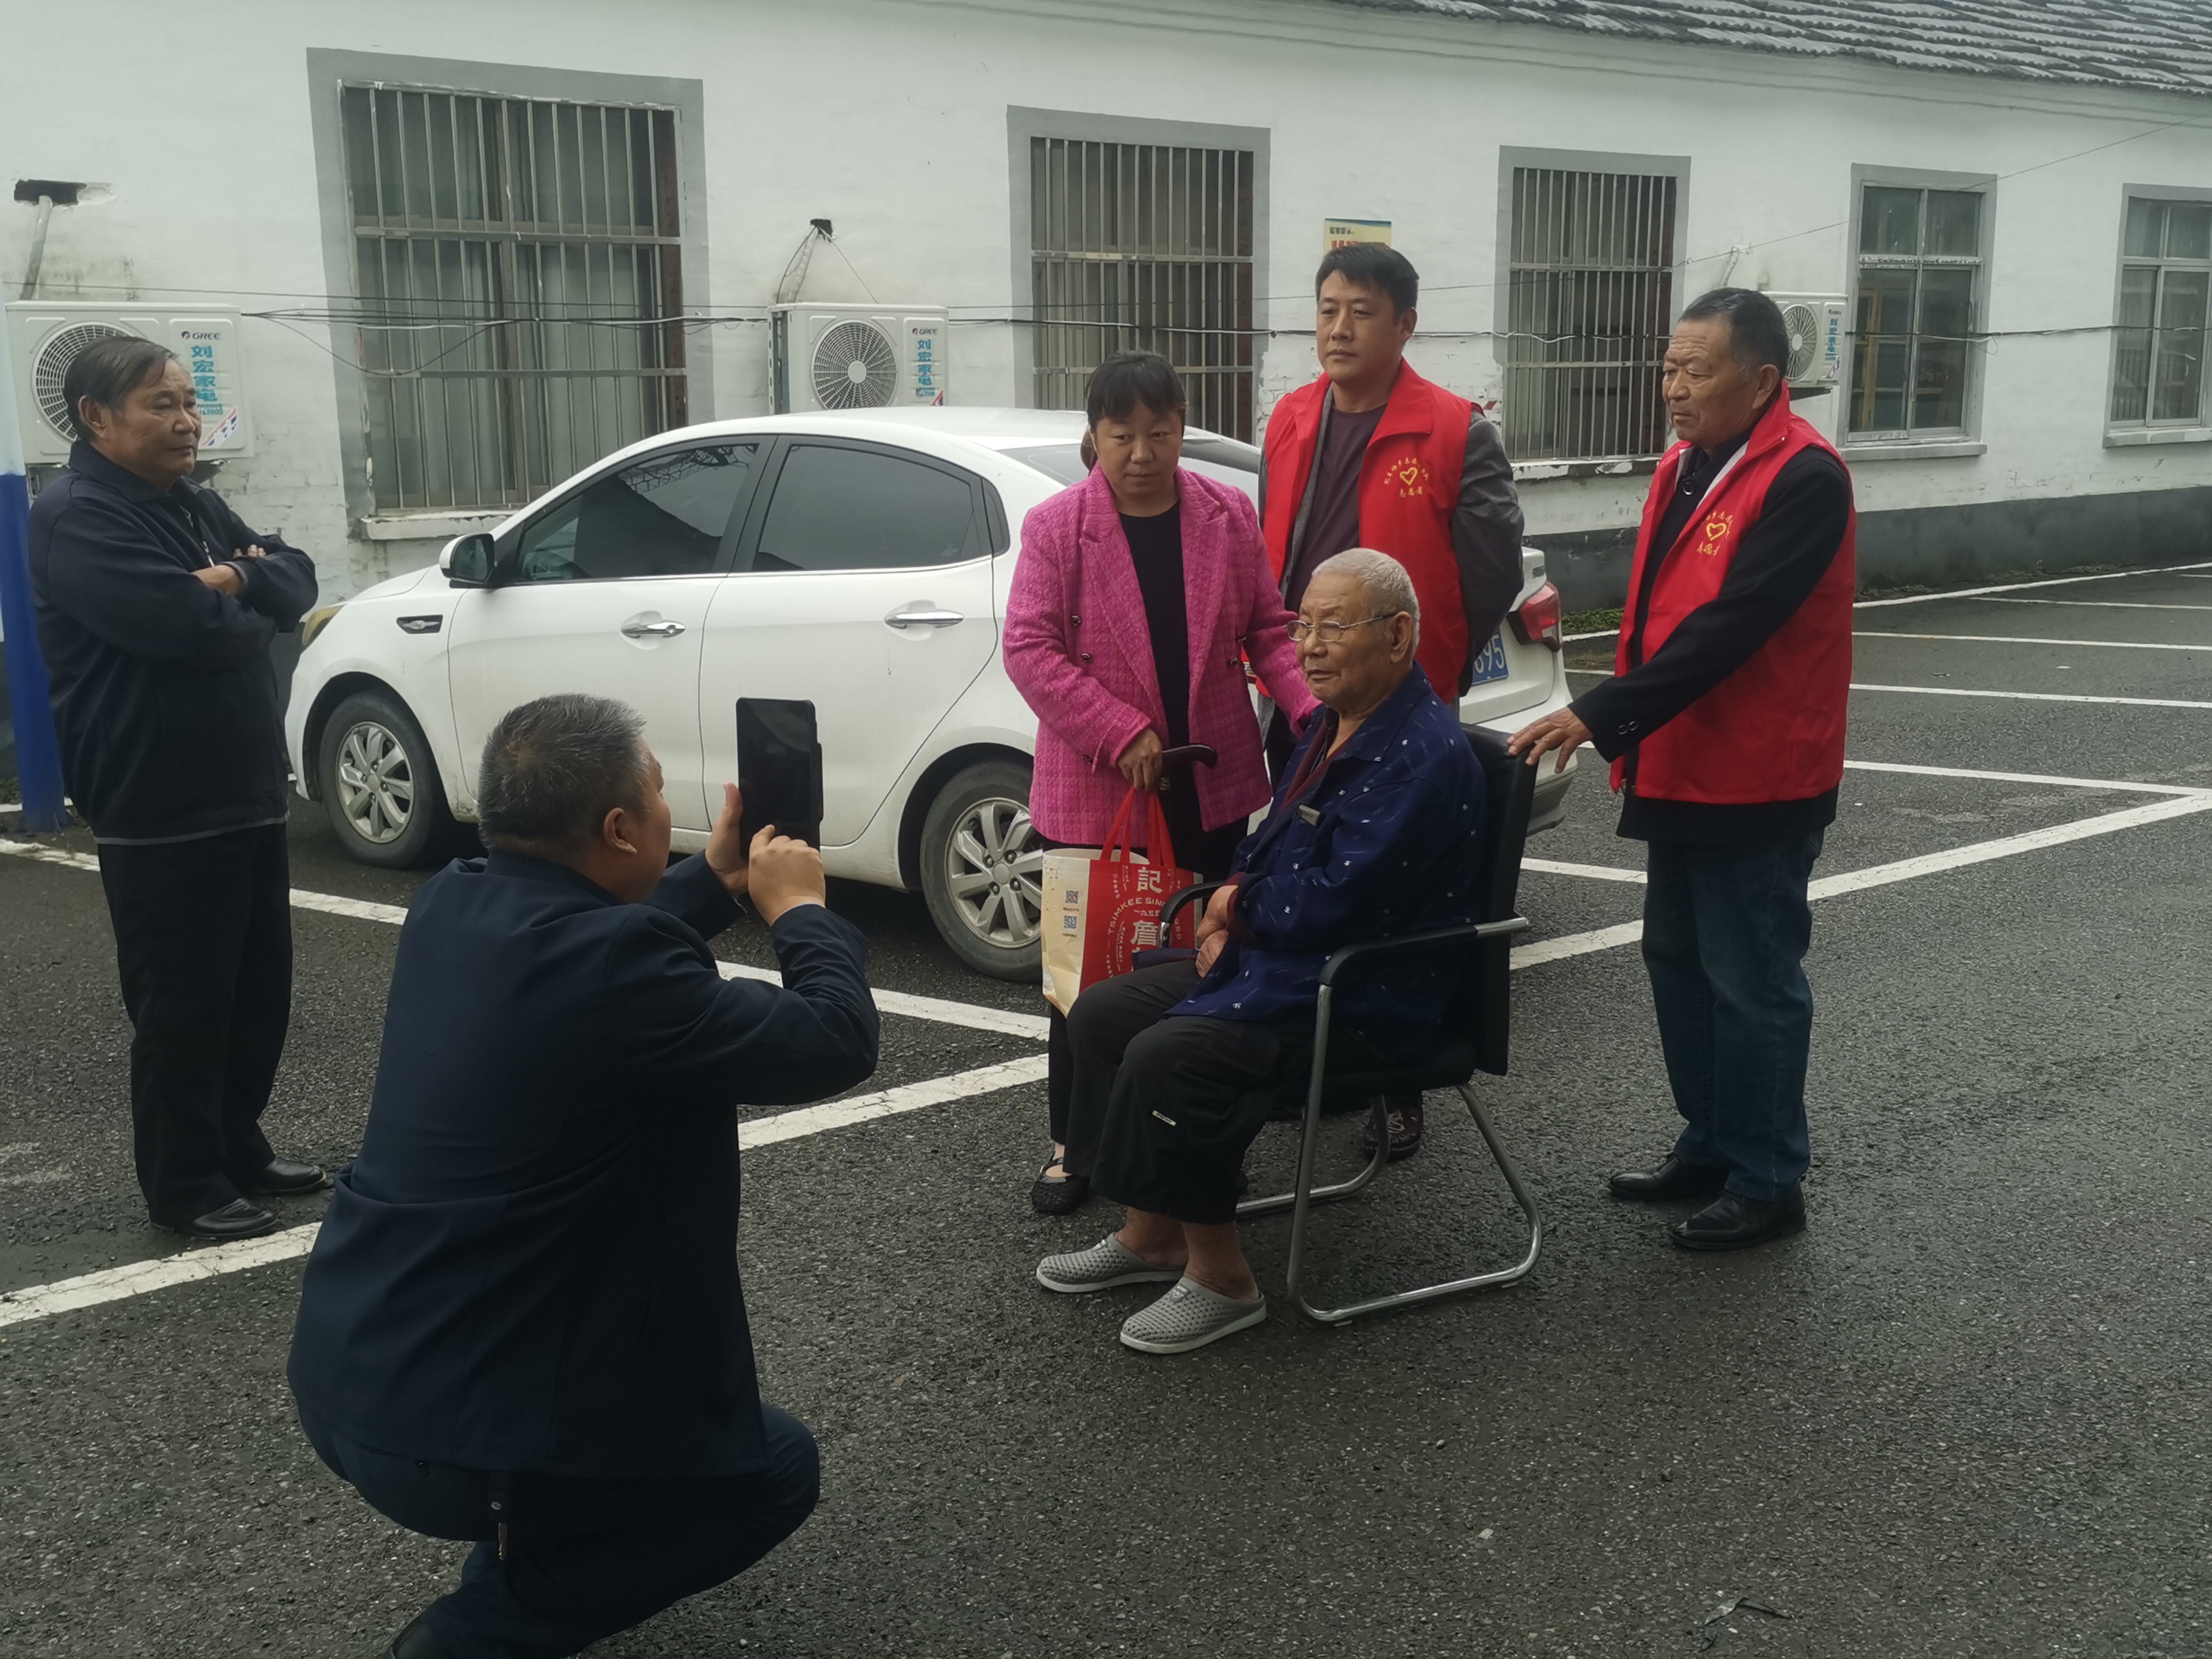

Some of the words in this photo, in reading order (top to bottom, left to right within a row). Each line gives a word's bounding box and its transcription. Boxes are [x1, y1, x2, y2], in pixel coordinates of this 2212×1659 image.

[1137, 866, 1163, 894] 記
[1108, 898, 1143, 935] TSIMKEE
[1130, 920, 1159, 946] 詹
